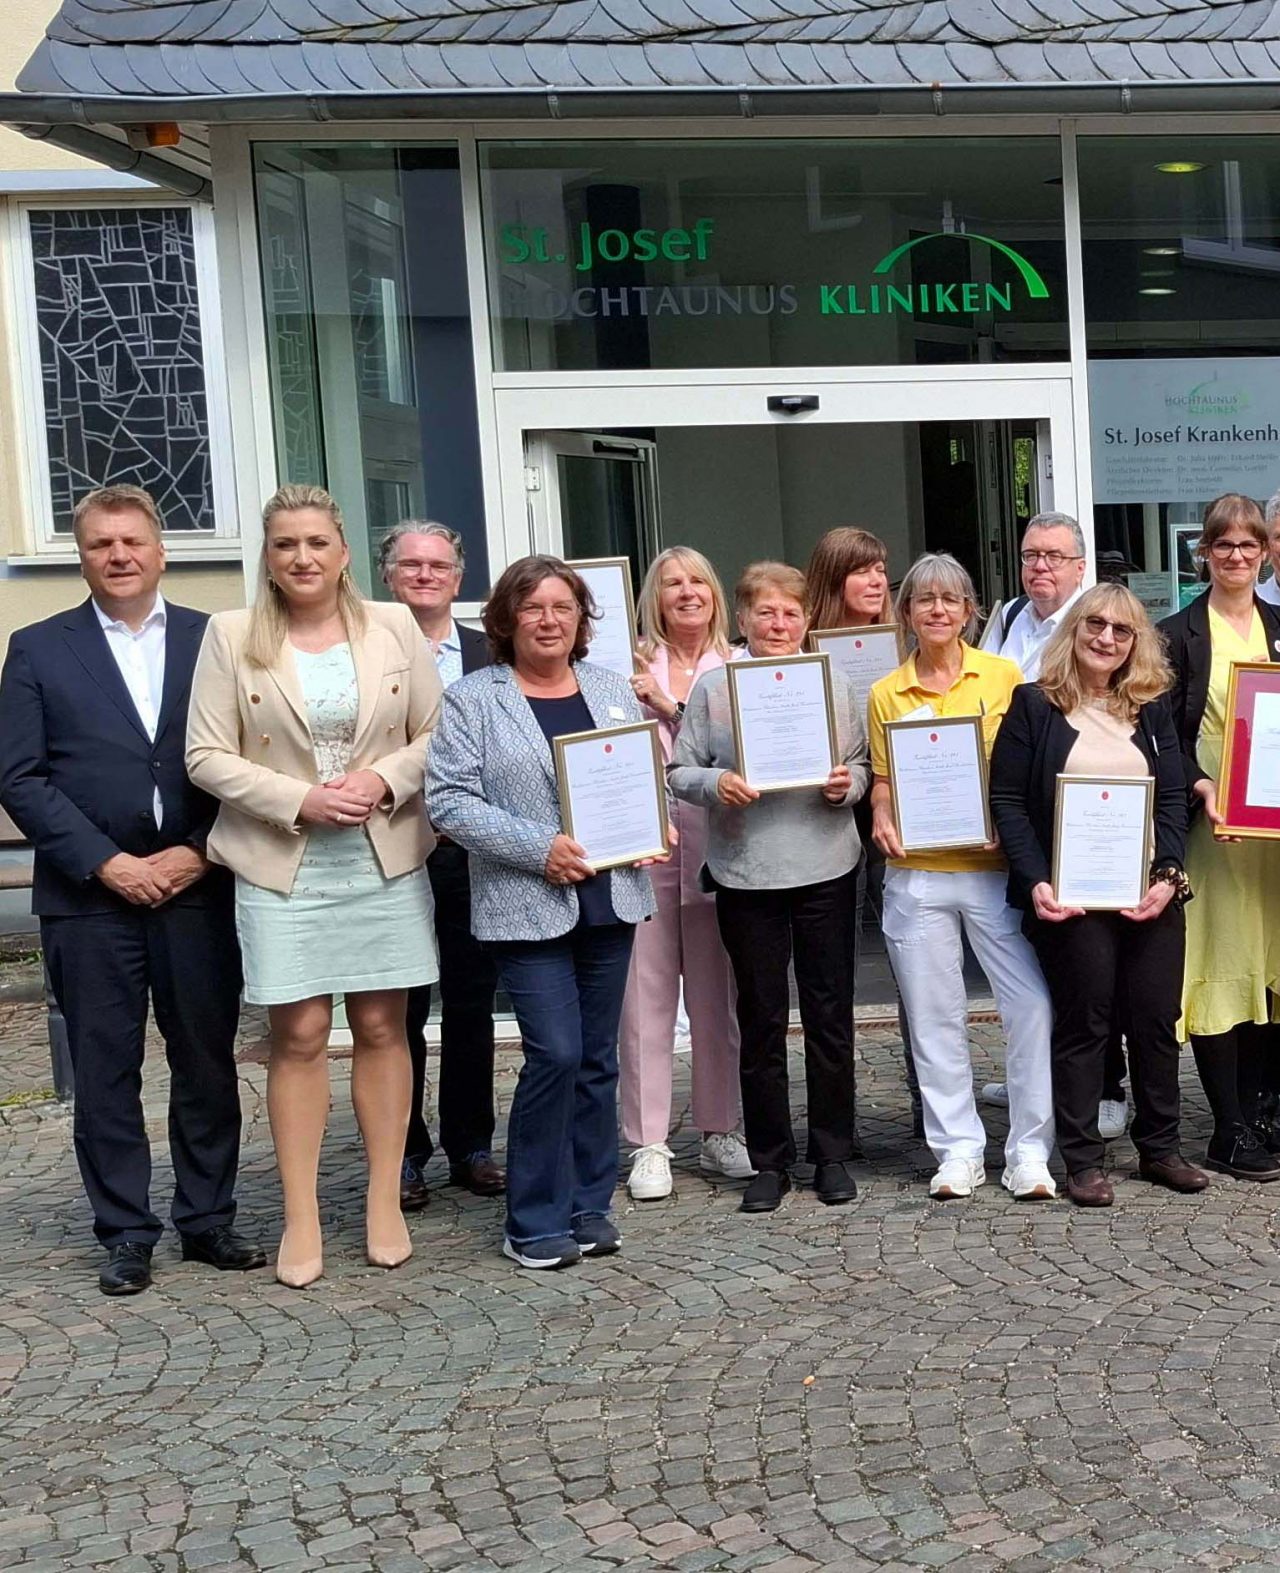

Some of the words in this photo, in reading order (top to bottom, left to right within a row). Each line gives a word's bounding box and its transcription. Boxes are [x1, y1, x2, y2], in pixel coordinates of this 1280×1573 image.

[503, 224, 566, 263] St.
[576, 219, 713, 271] Josef
[820, 283, 1012, 314] KLINIKEN
[1165, 396, 1238, 406] HOCHTAUNUS
[1104, 428, 1128, 444] St.
[1134, 425, 1182, 447] Josef
